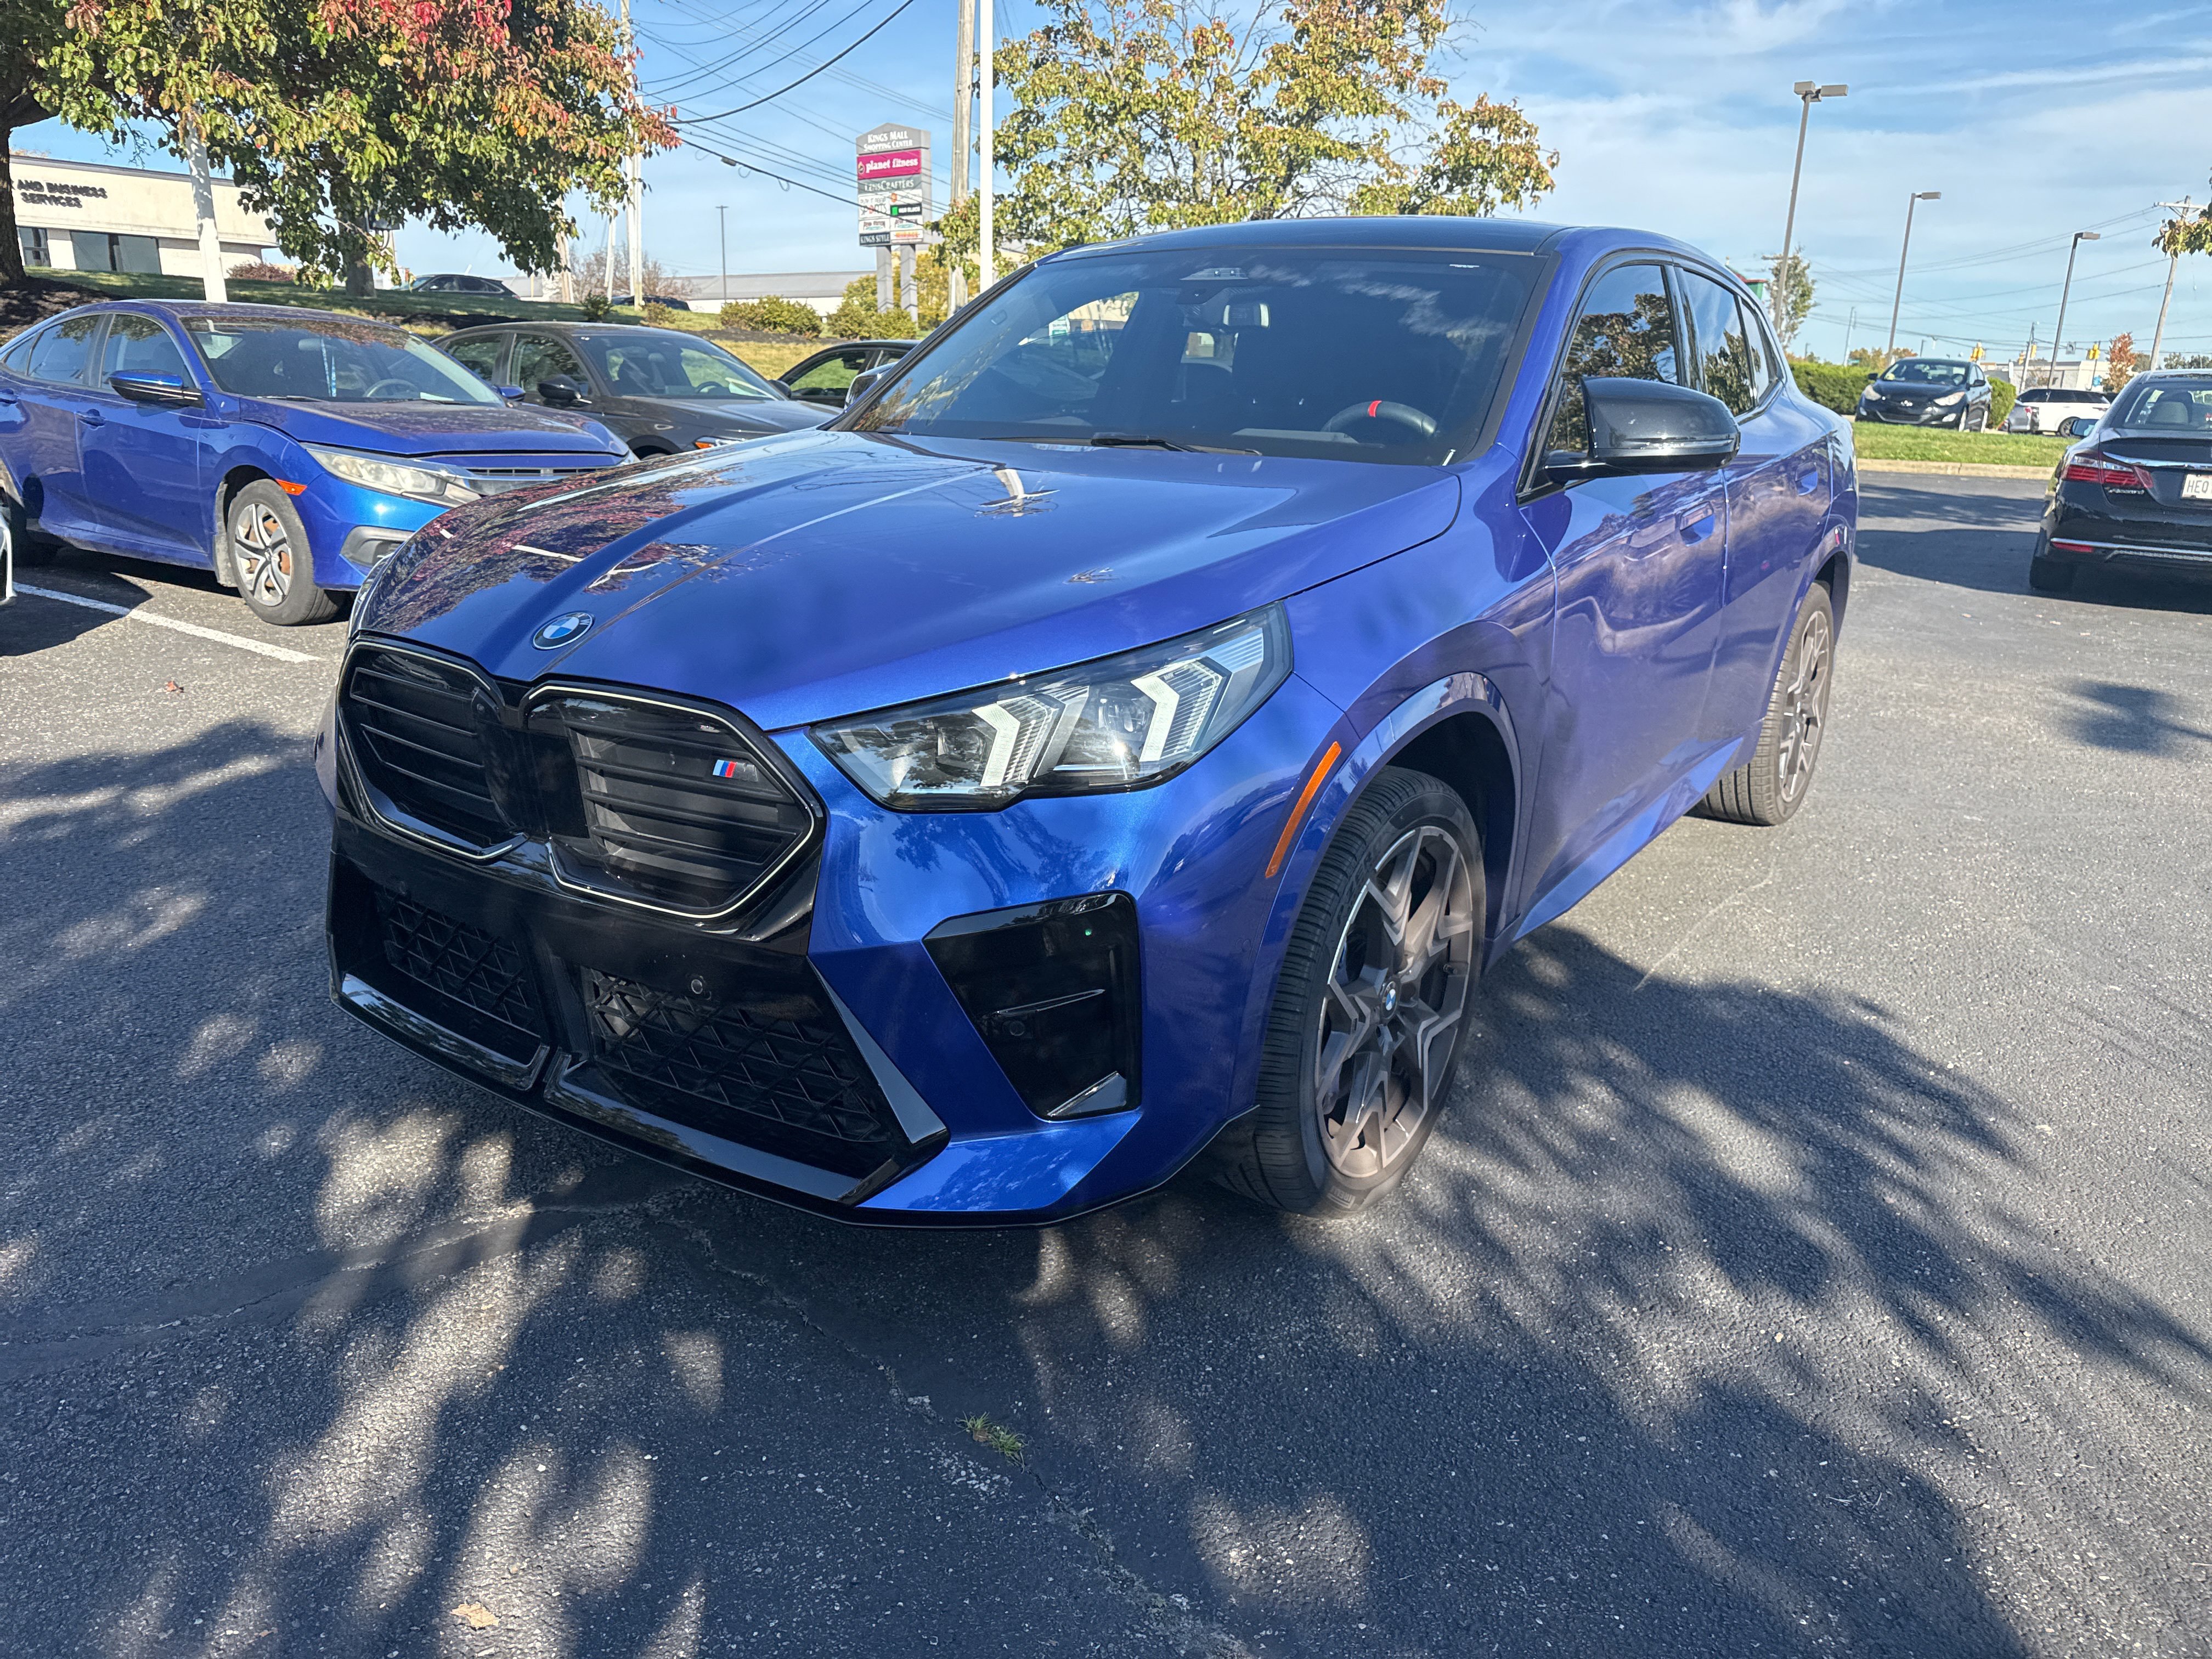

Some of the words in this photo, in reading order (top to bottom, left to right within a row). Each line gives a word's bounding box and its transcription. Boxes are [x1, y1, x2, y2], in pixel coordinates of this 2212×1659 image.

[890, 131, 908, 140] MALL
[891, 139, 913, 148] CENTER
[866, 160, 890, 173] planet
[892, 158, 918, 168] fitness
[17, 179, 44, 192] AND
[46, 182, 108, 199] BUSINESS
[20, 192, 82, 208] SERVICES
